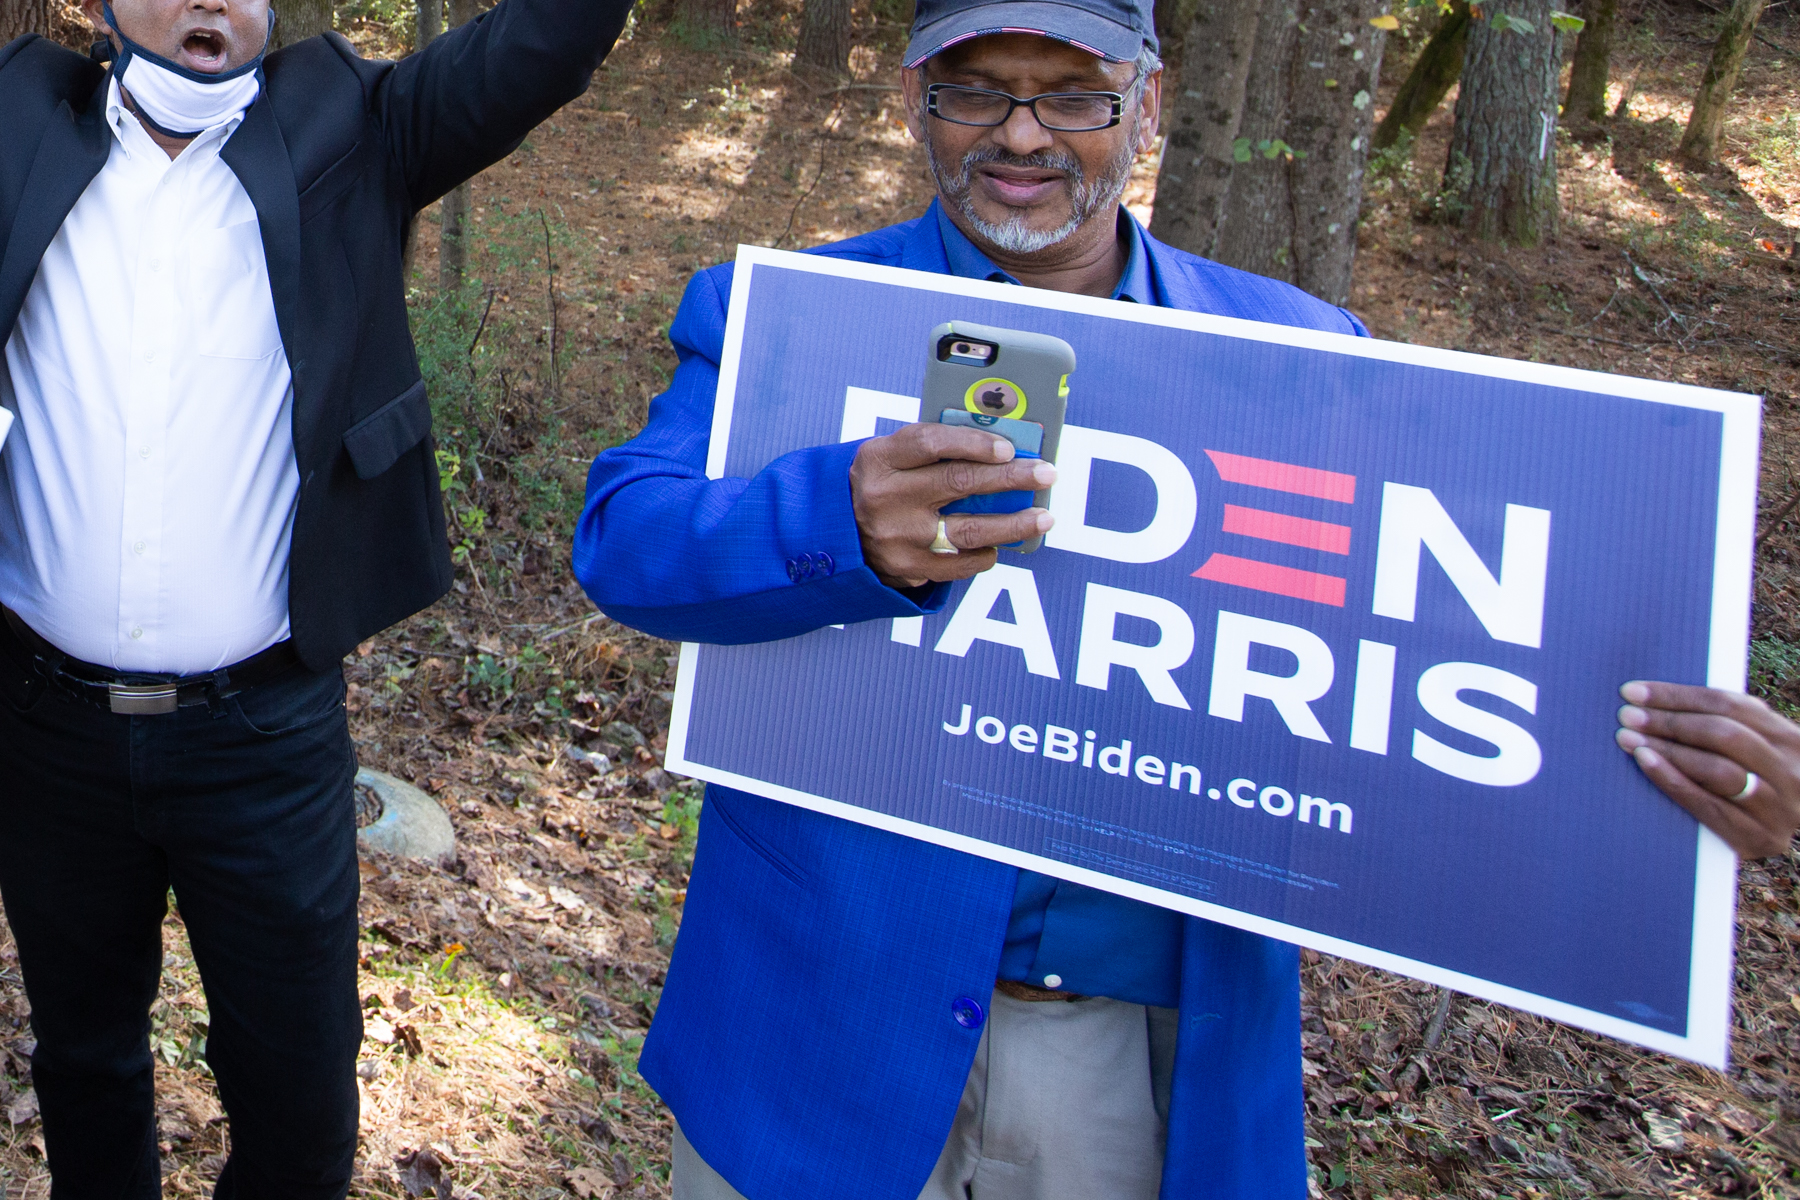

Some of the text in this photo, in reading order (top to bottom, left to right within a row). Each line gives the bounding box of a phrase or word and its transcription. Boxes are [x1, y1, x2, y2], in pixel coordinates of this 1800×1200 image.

[840, 385, 1551, 649] DEN
[829, 562, 1541, 787] ARRIS
[943, 704, 1353, 834] JoeBiden.com
